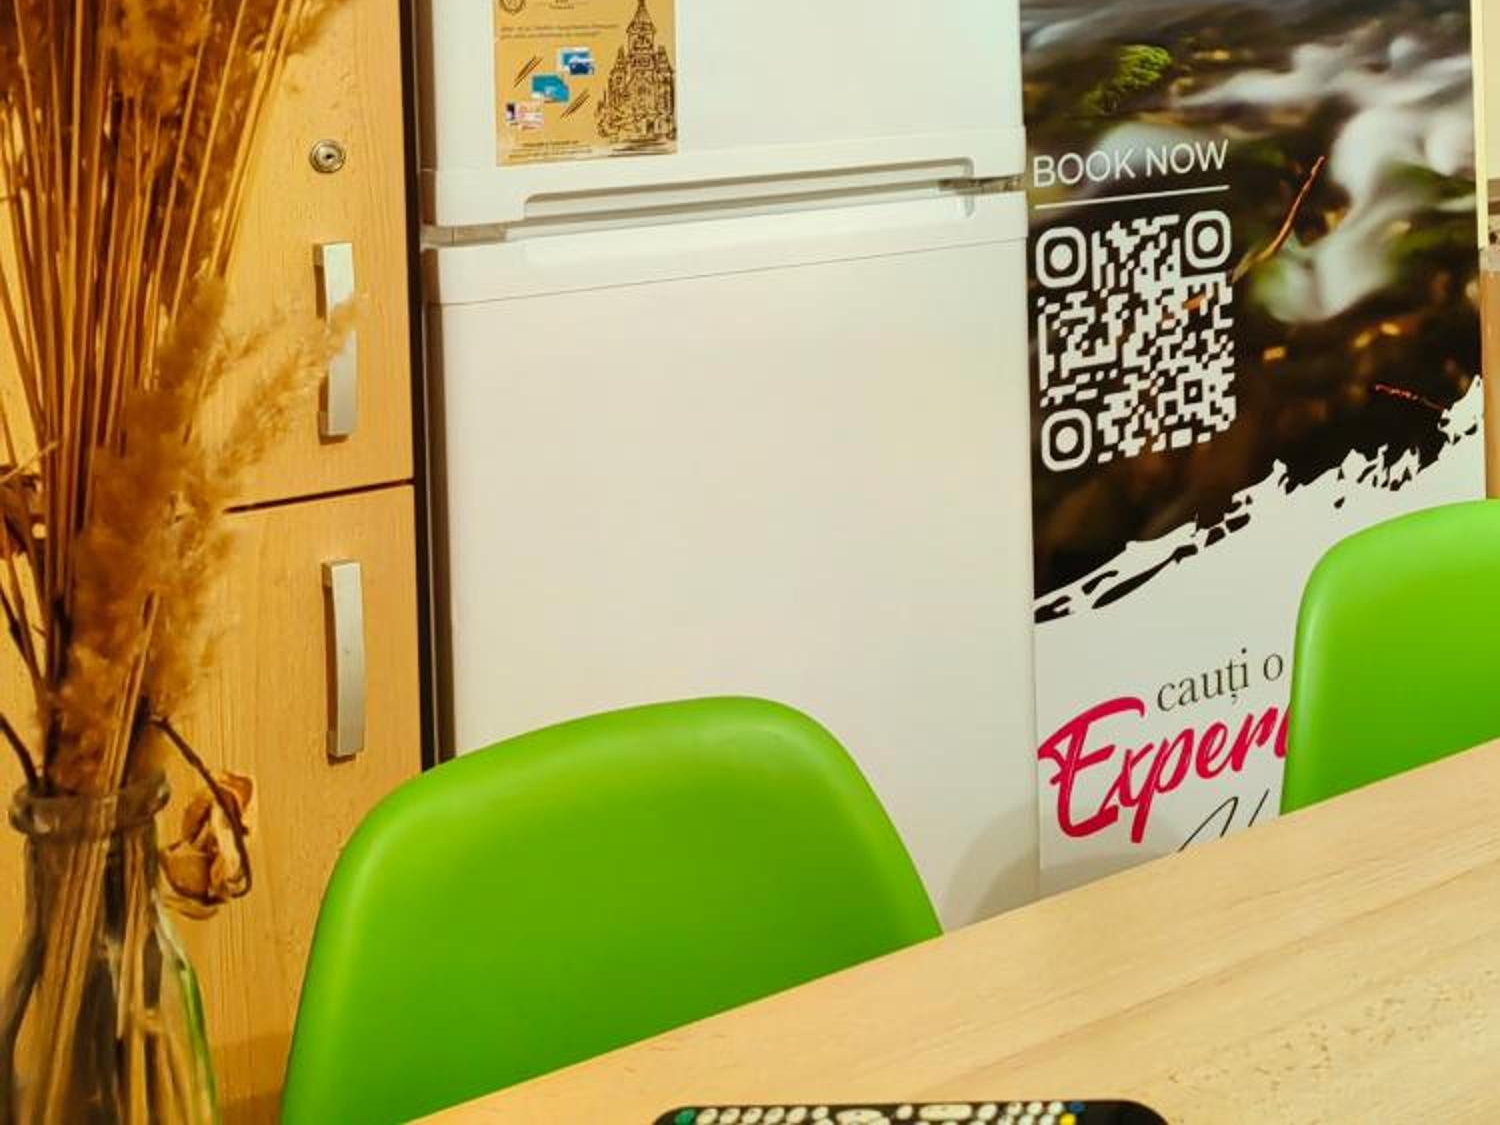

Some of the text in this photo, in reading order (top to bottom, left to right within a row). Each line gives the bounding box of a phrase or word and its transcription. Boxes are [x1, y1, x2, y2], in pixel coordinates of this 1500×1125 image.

[1033, 138, 1229, 188] BOOK NOW
[1156, 647, 1284, 712] cauți o
